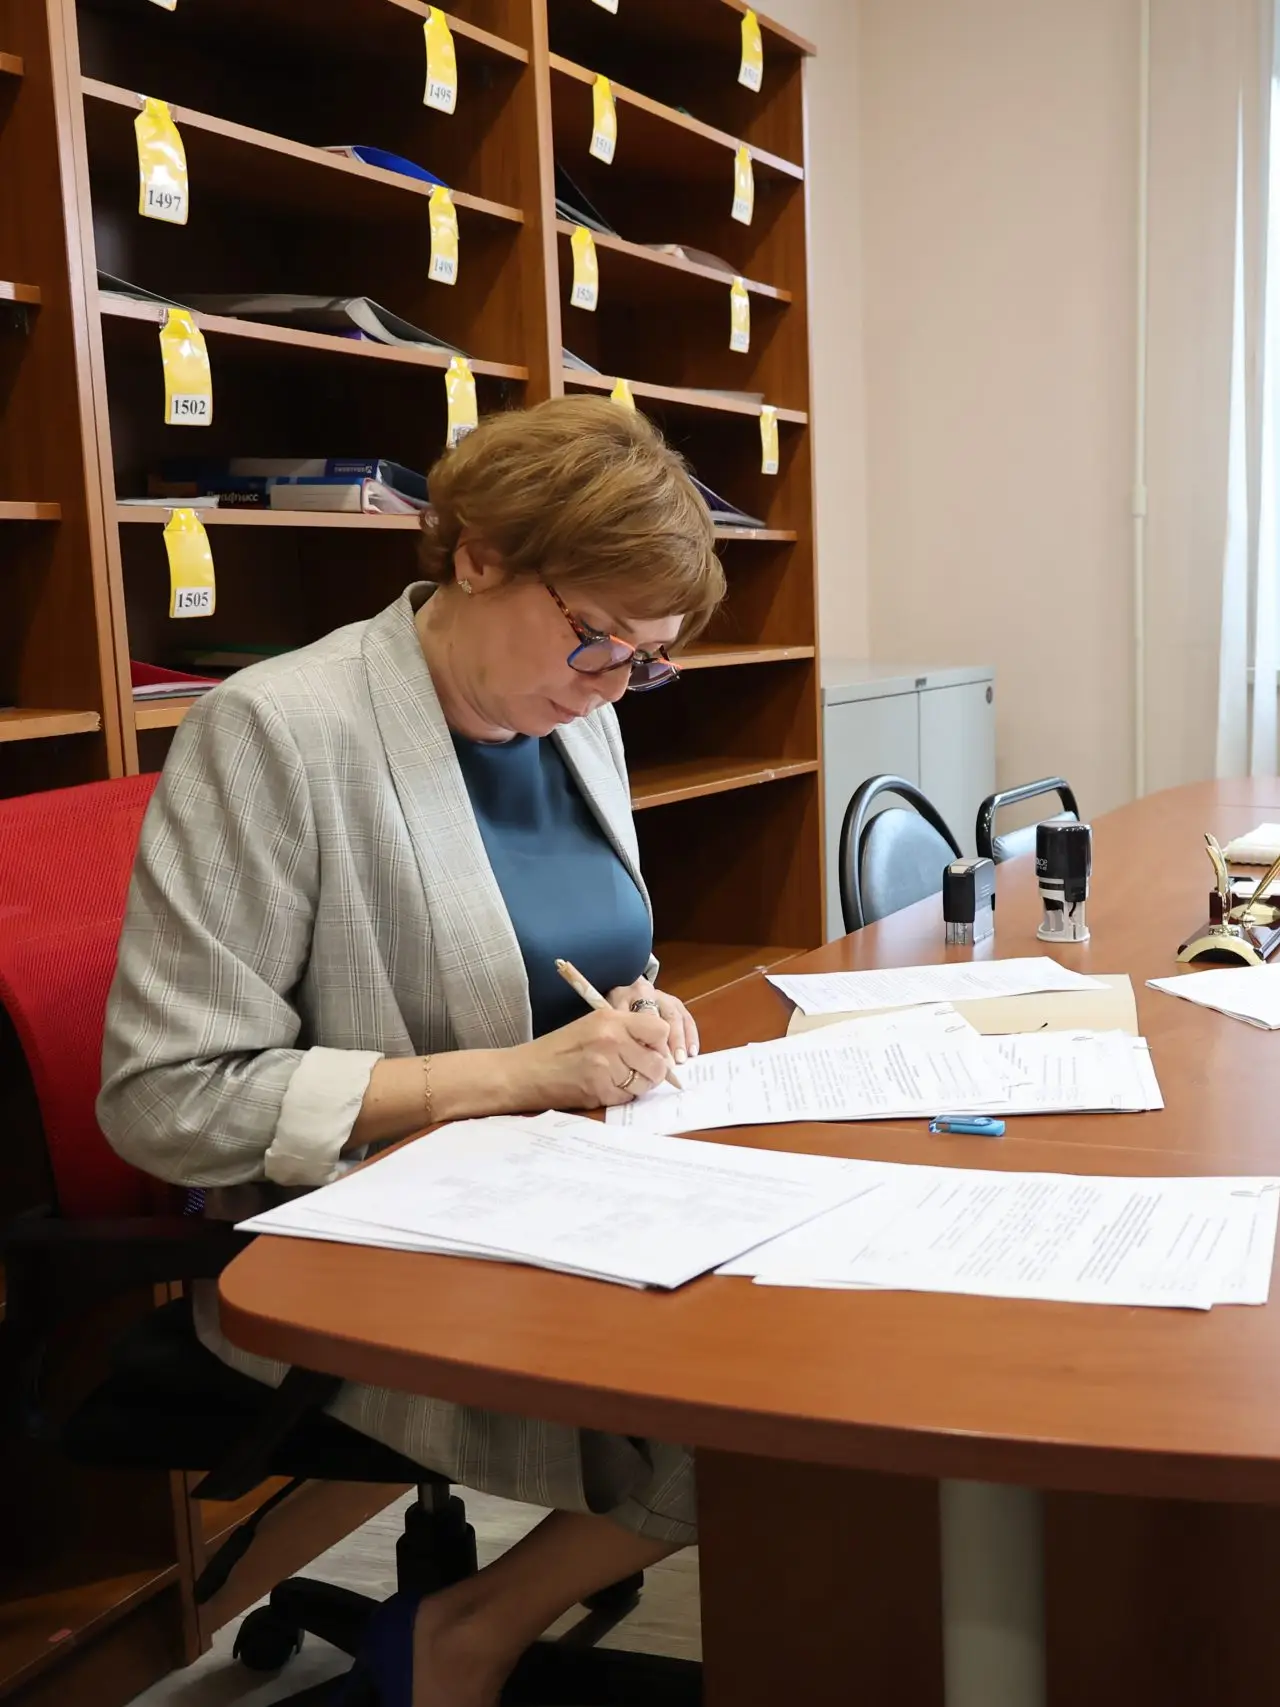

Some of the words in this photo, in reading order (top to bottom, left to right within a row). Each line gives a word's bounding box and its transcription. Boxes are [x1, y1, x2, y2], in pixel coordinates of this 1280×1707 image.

[429, 84, 452, 103] 1495
[149, 189, 182, 212] 1497
[174, 399, 206, 415] 1502
[178, 592, 209, 608] 1505
